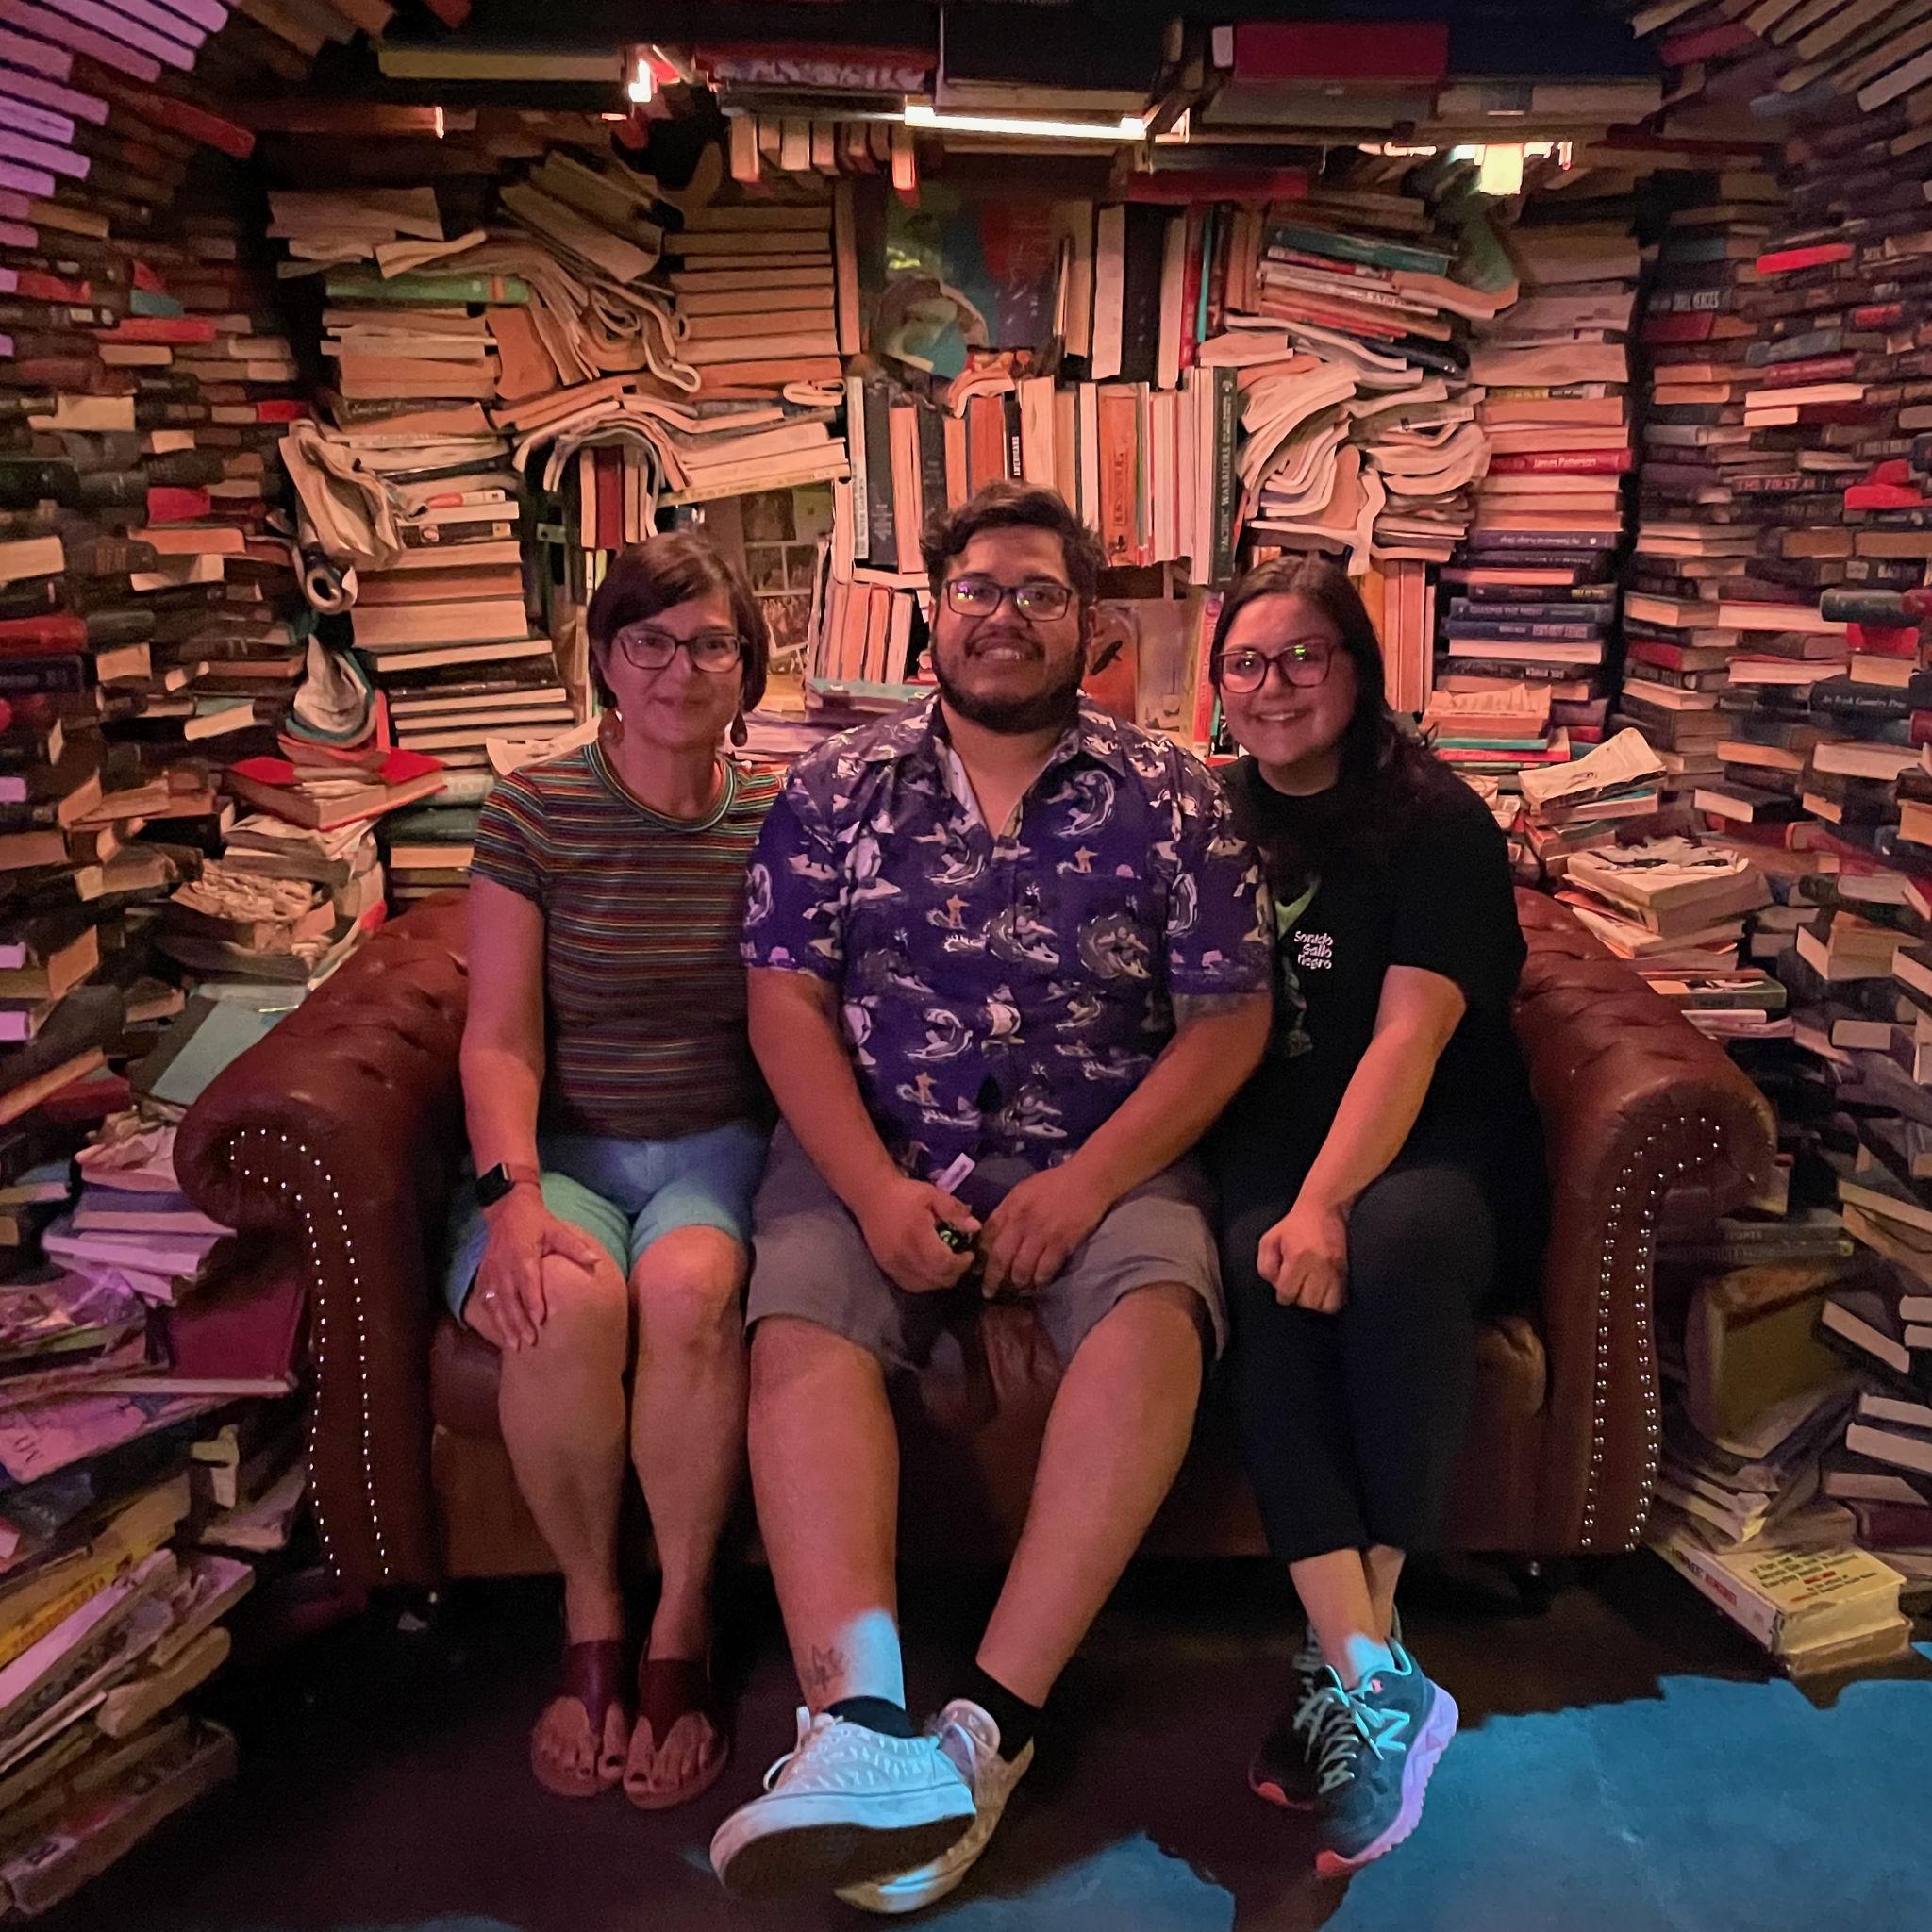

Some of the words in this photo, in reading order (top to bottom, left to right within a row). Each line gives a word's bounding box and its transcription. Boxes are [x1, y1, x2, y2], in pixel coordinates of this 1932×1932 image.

[1221, 447, 1231, 506] WARRIORS
[1533, 458, 1557, 469] James
[1558, 457, 1596, 468] Patterson
[1220, 508, 1229, 552] PACIFIC
